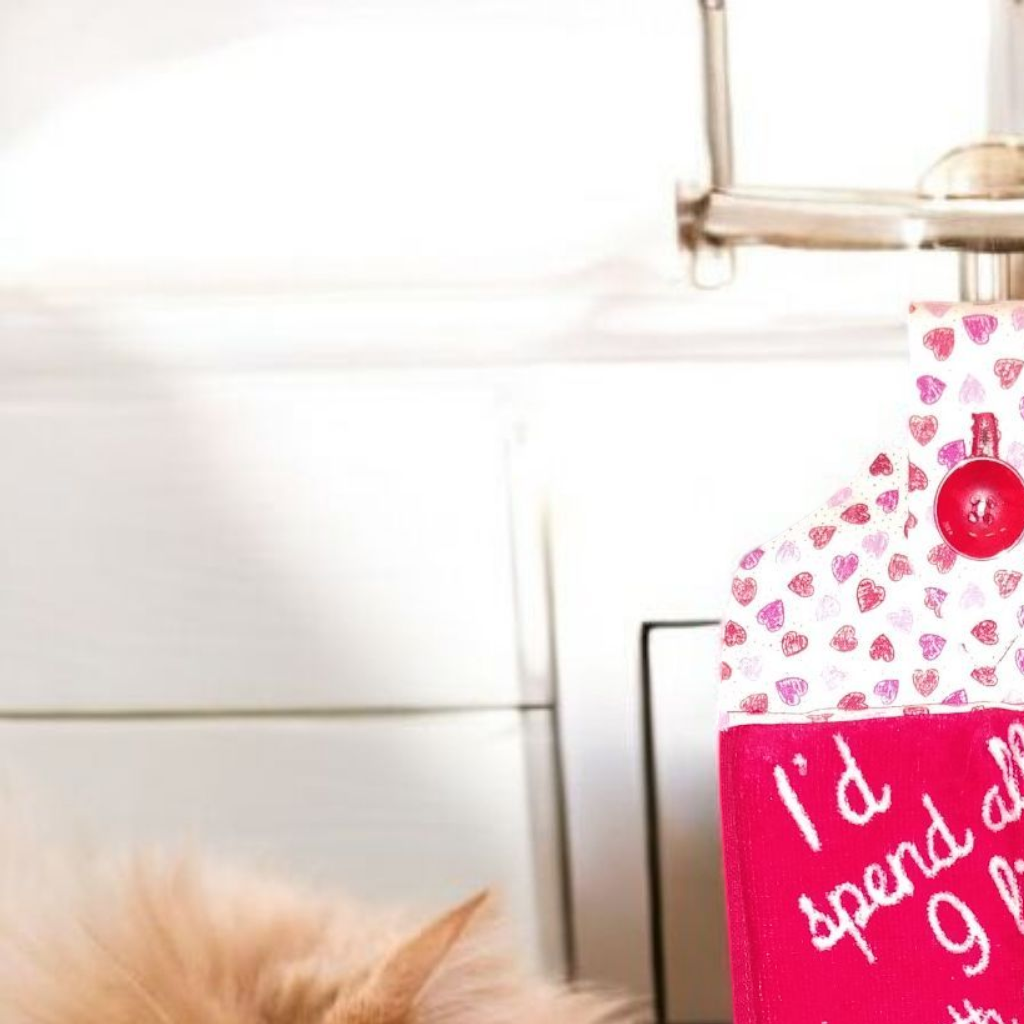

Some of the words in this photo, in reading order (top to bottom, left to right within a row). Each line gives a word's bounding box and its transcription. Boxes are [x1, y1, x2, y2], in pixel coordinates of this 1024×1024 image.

[772, 733, 892, 852] I'd
[798, 793, 975, 963] spend
[926, 892, 991, 977] 9
